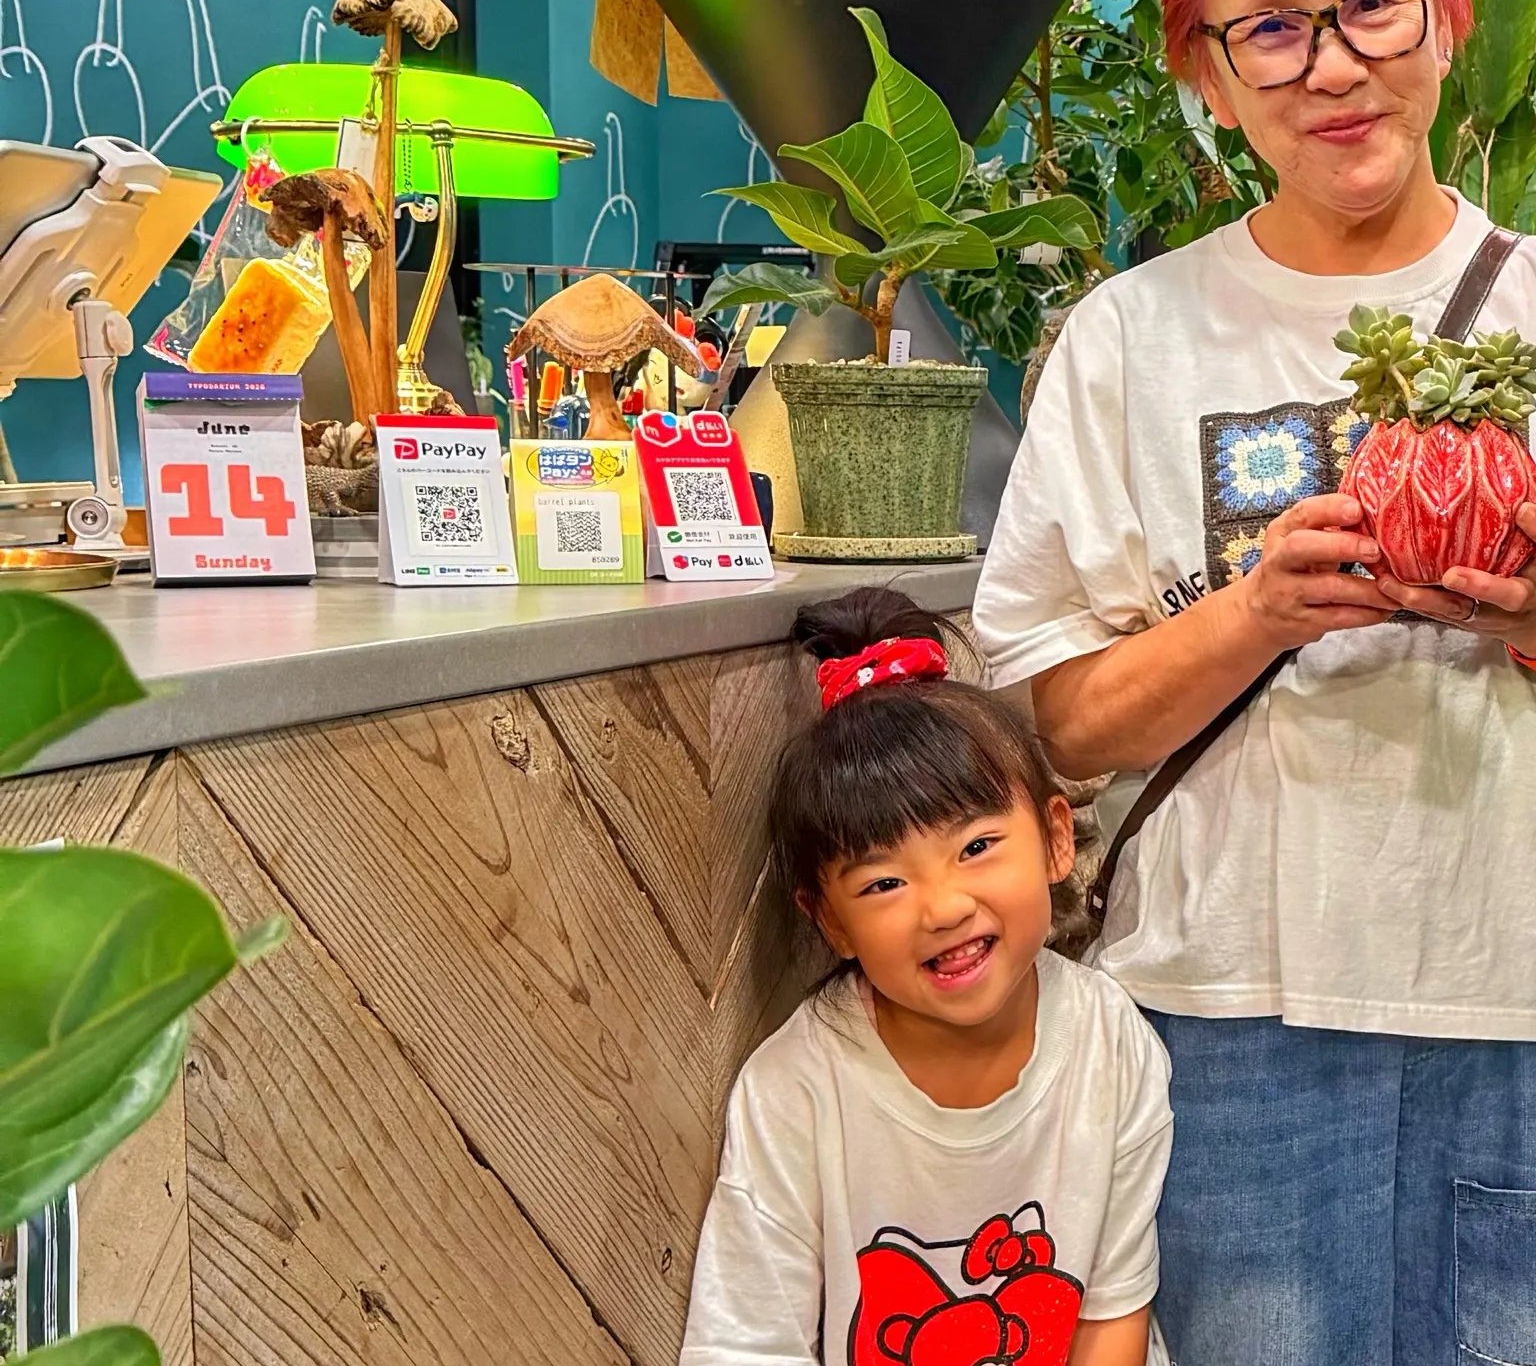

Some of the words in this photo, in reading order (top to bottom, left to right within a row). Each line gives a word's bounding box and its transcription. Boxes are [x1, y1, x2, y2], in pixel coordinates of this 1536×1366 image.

[197, 420, 251, 435] June
[421, 441, 487, 460] PayPay
[160, 463, 296, 537] 14
[195, 554, 272, 572] Sunday
[691, 556, 713, 568] Pay
